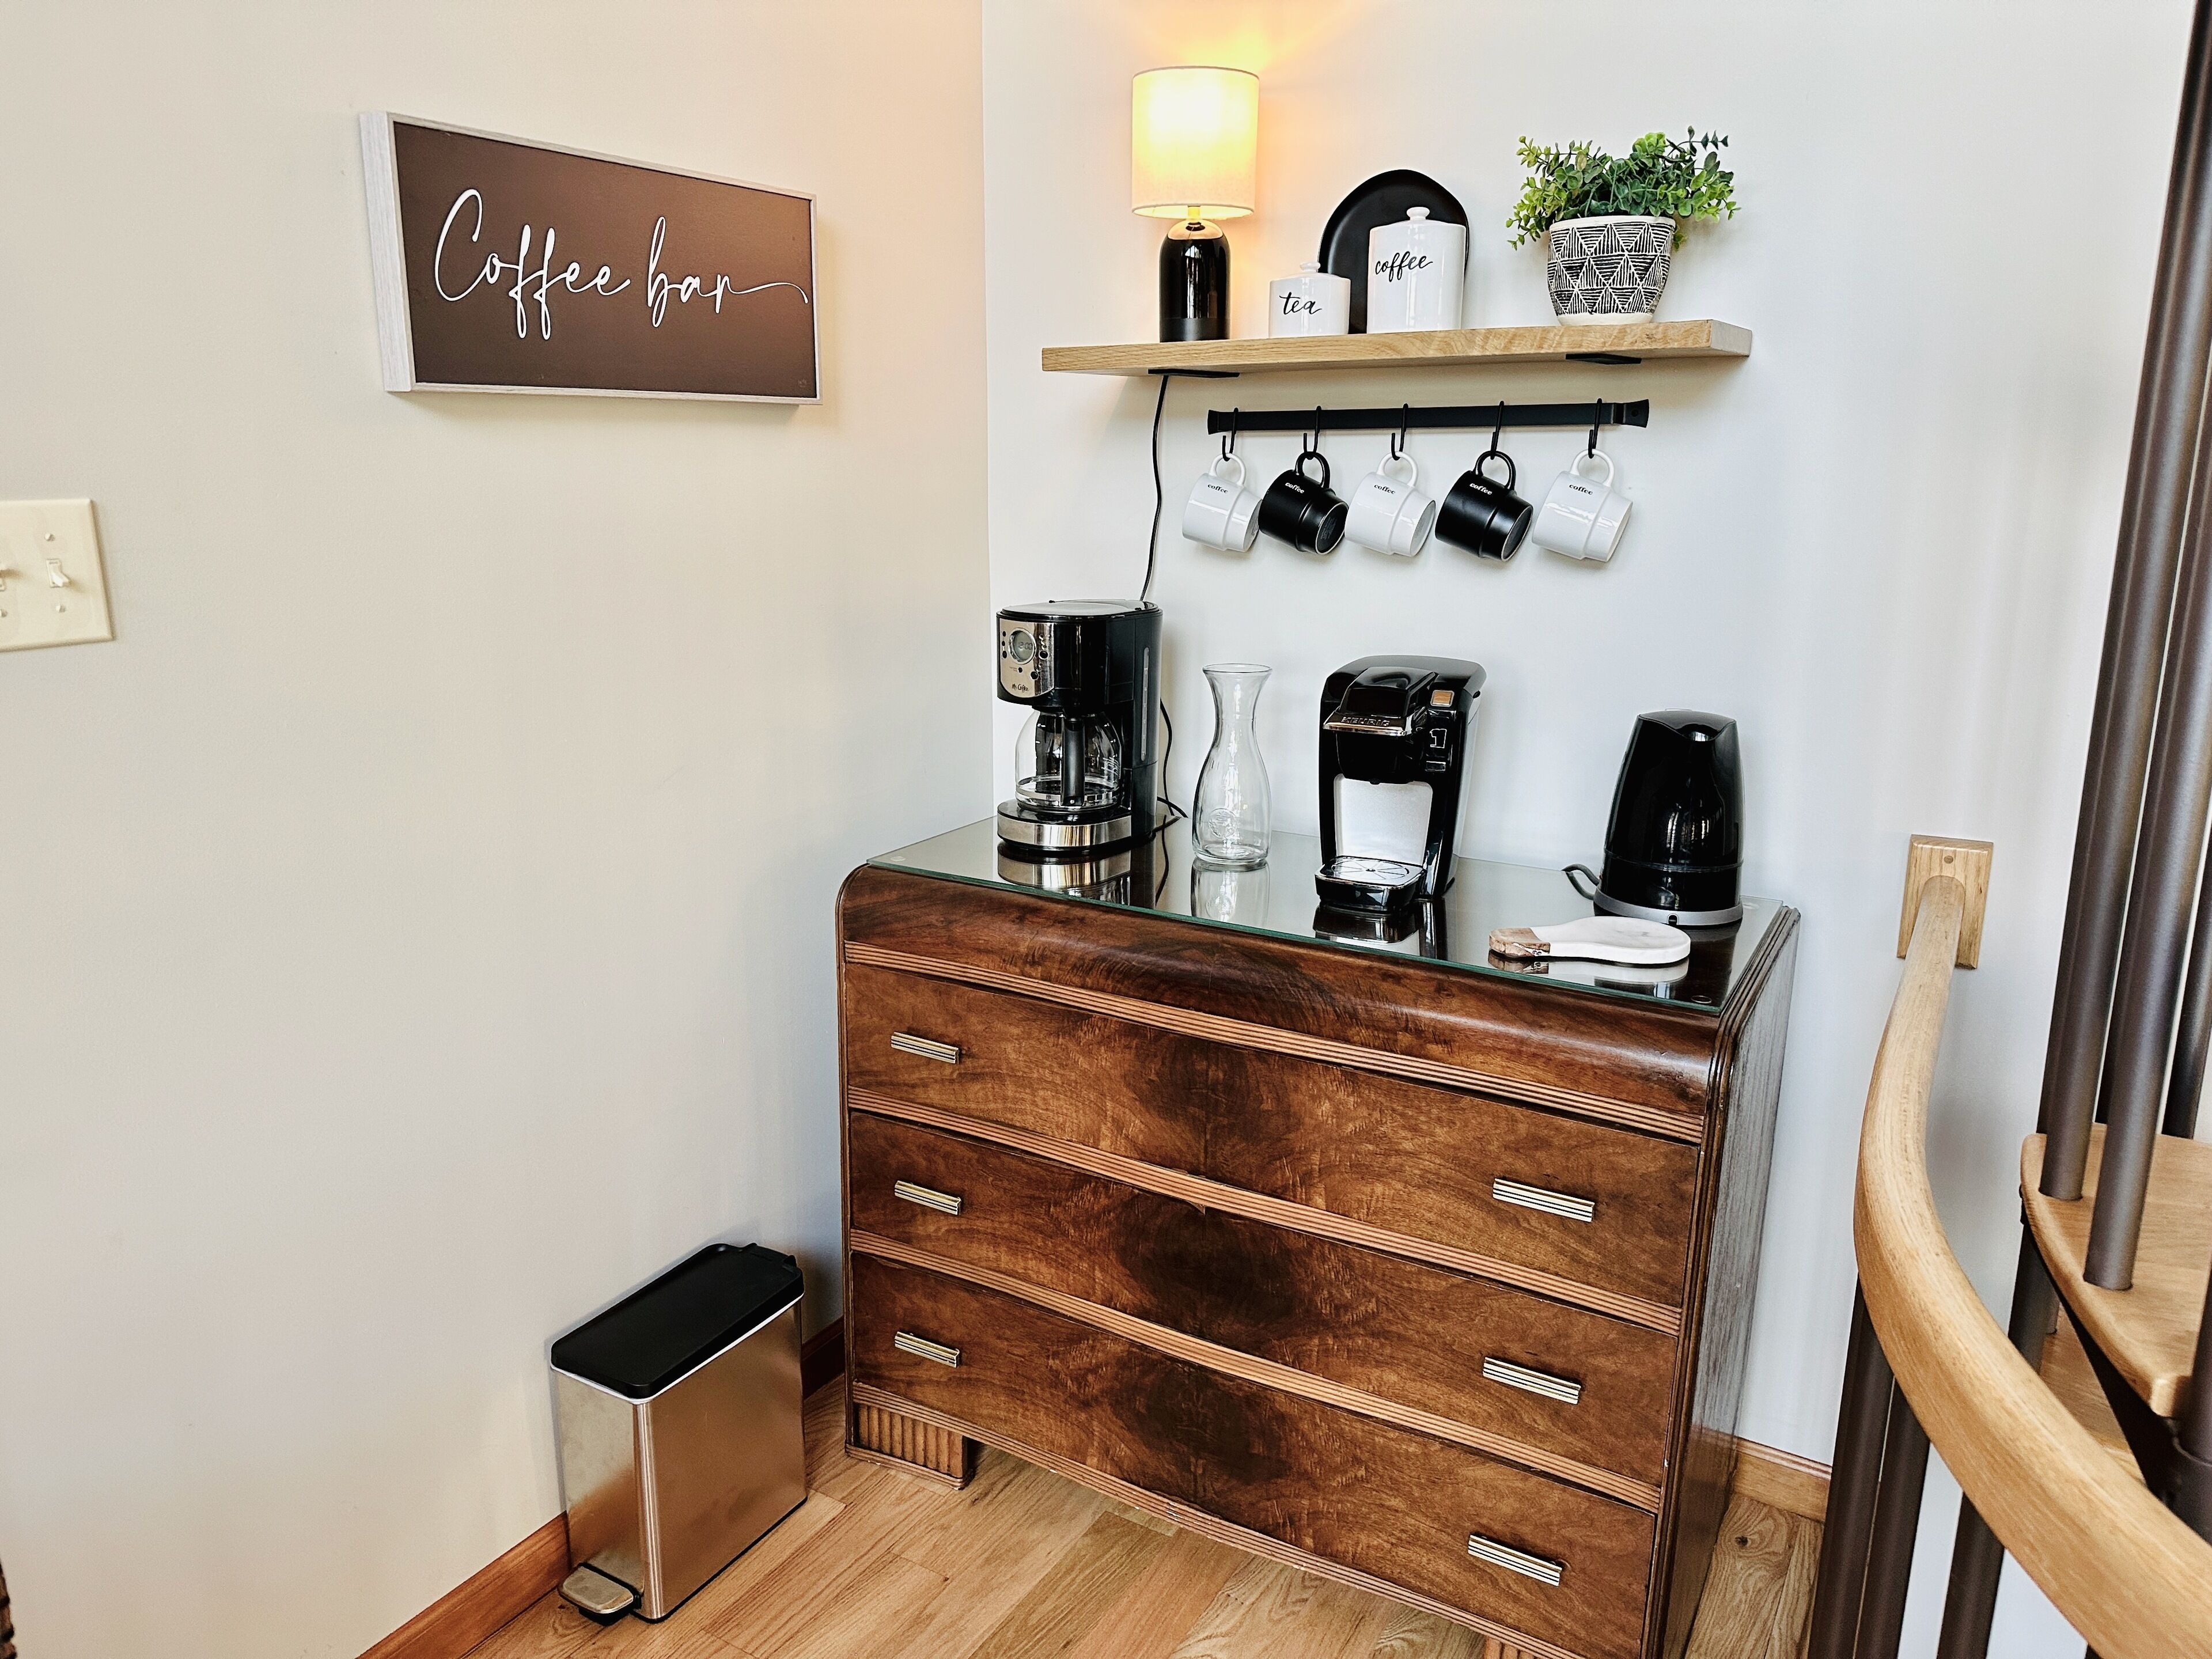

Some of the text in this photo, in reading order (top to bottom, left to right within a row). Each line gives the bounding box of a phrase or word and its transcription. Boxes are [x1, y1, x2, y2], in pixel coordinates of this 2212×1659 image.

[434, 188, 808, 340] Coffee bar
[1374, 251, 1433, 282] coffee
[1279, 291, 1323, 315] tea
[1207, 484, 1229, 494] coffee
[1285, 482, 1305, 494] coffee
[1374, 484, 1396, 495] coffee
[1469, 483, 1493, 495] coffee
[1569, 484, 1593, 495] coffee
[1341, 717, 1389, 726] KEURIG
